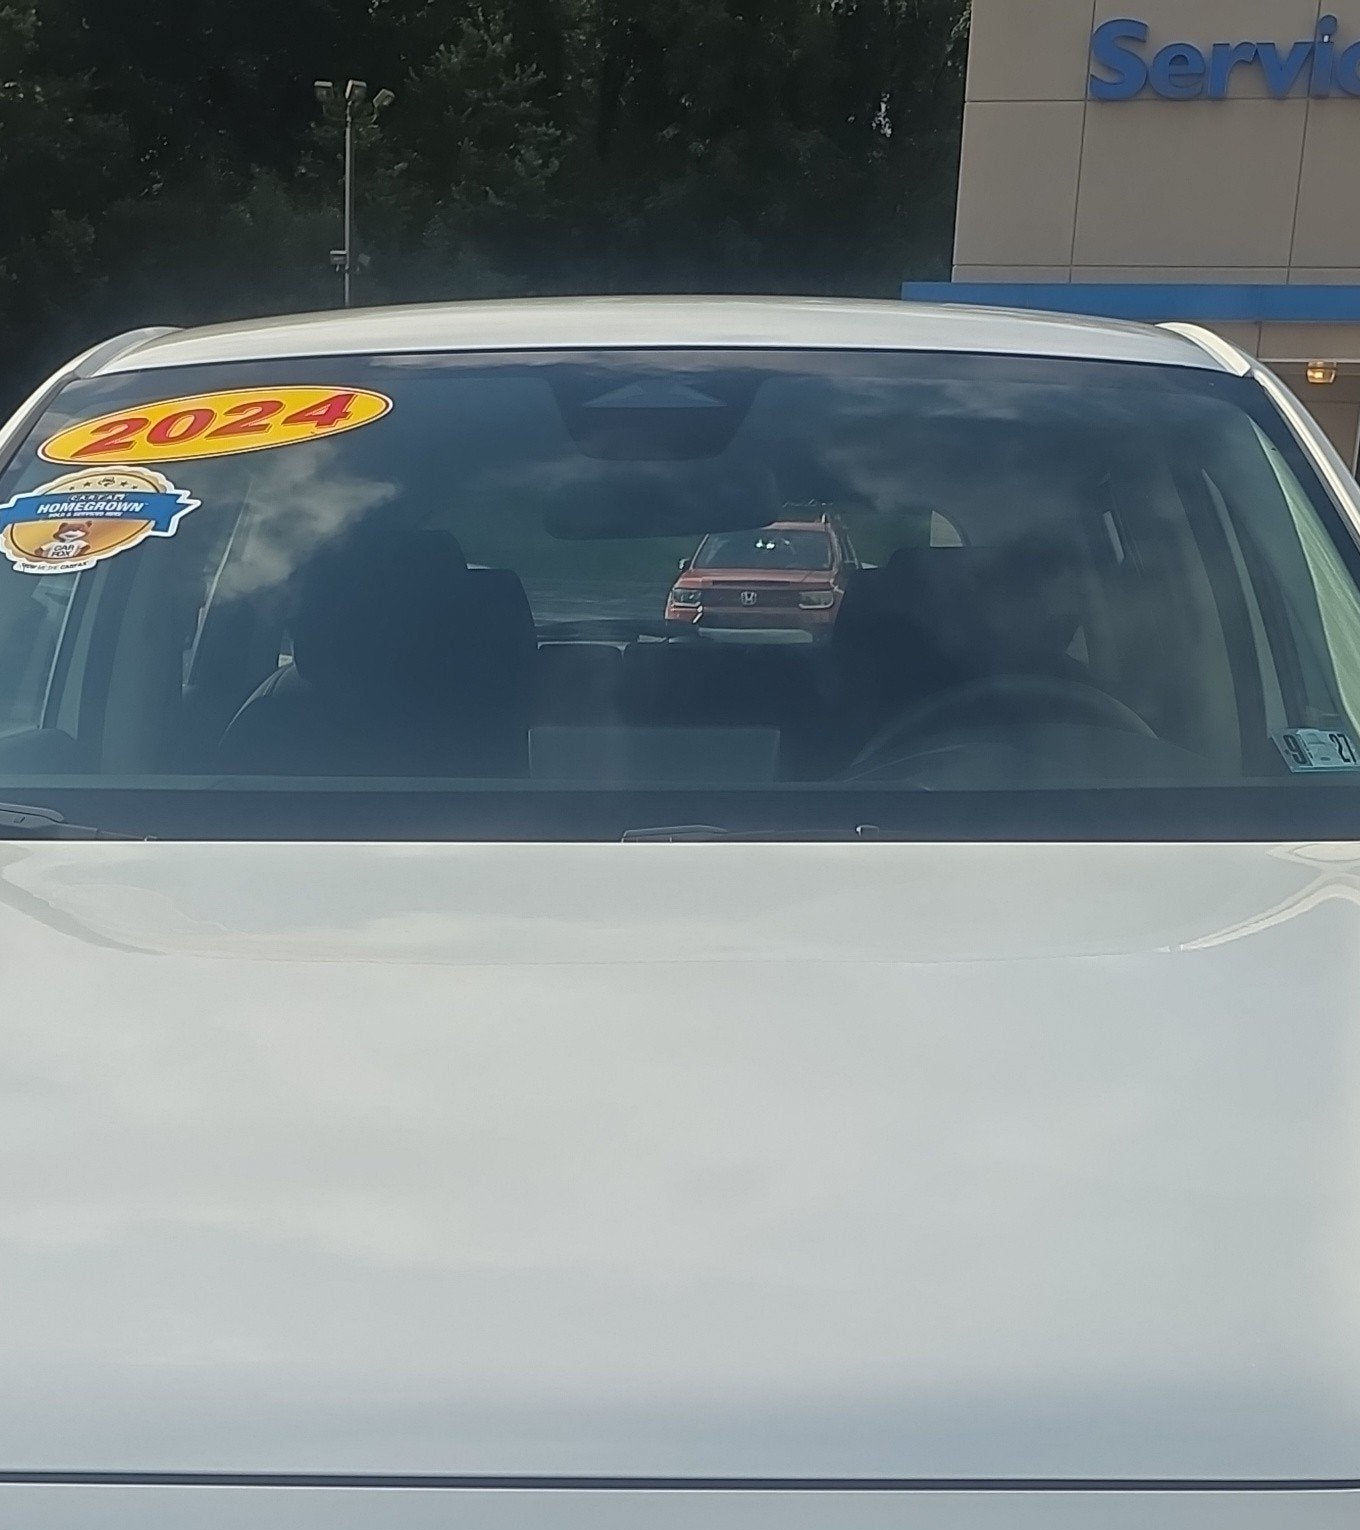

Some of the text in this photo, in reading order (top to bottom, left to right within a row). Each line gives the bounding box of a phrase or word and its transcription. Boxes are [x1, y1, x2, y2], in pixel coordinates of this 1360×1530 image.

[69, 392, 359, 459] 2024
[36, 502, 145, 515] HOMEGROWN
[53, 544, 75, 552] CAR
[1328, 733, 1357, 764] 27
